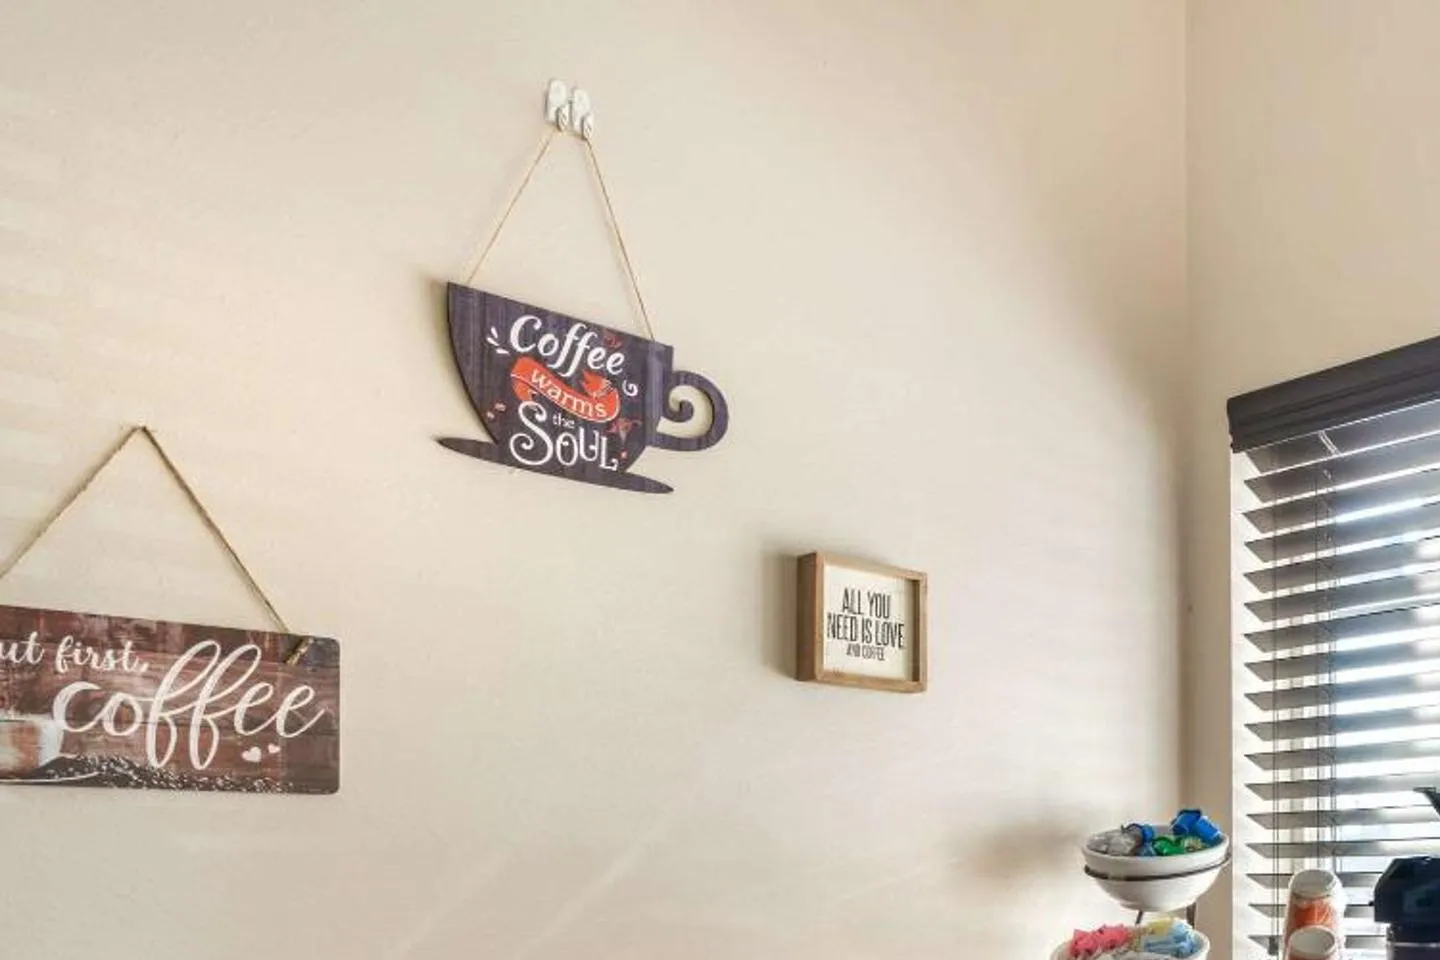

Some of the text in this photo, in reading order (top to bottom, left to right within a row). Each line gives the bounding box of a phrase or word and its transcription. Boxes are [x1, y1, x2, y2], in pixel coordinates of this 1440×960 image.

[509, 315, 624, 377] Coffee
[531, 368, 608, 419] warms
[552, 412, 575, 430] the
[841, 587, 892, 619] ALL YOU
[827, 612, 905, 649] NEED IS LOVE
[0, 631, 149, 673] ut first,
[846, 643, 885, 661] AND COFFEE
